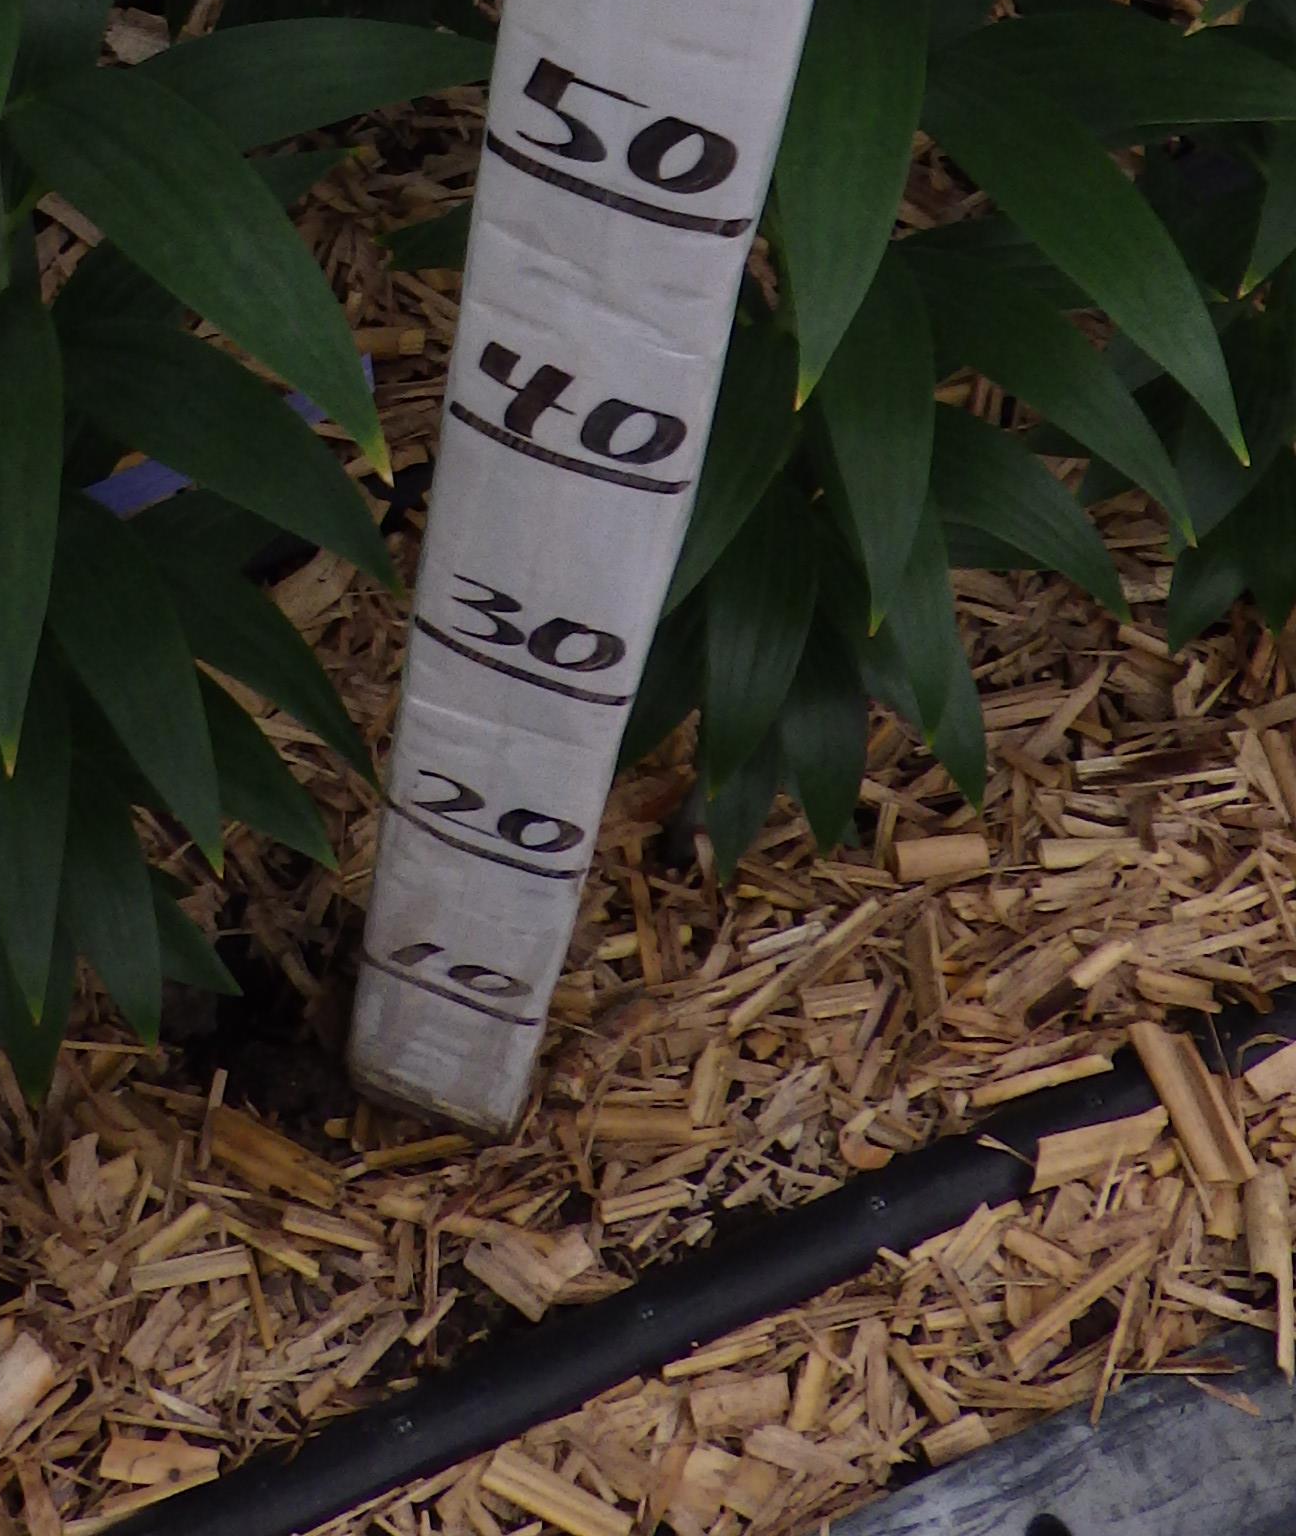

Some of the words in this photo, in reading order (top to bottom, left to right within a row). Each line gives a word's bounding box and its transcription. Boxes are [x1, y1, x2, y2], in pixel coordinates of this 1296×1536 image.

[516, 57, 739, 194] 50
[479, 341, 688, 465] 40
[450, 573, 627, 672] 30
[411, 768, 586, 853] 20
[388, 941, 534, 999] 10
